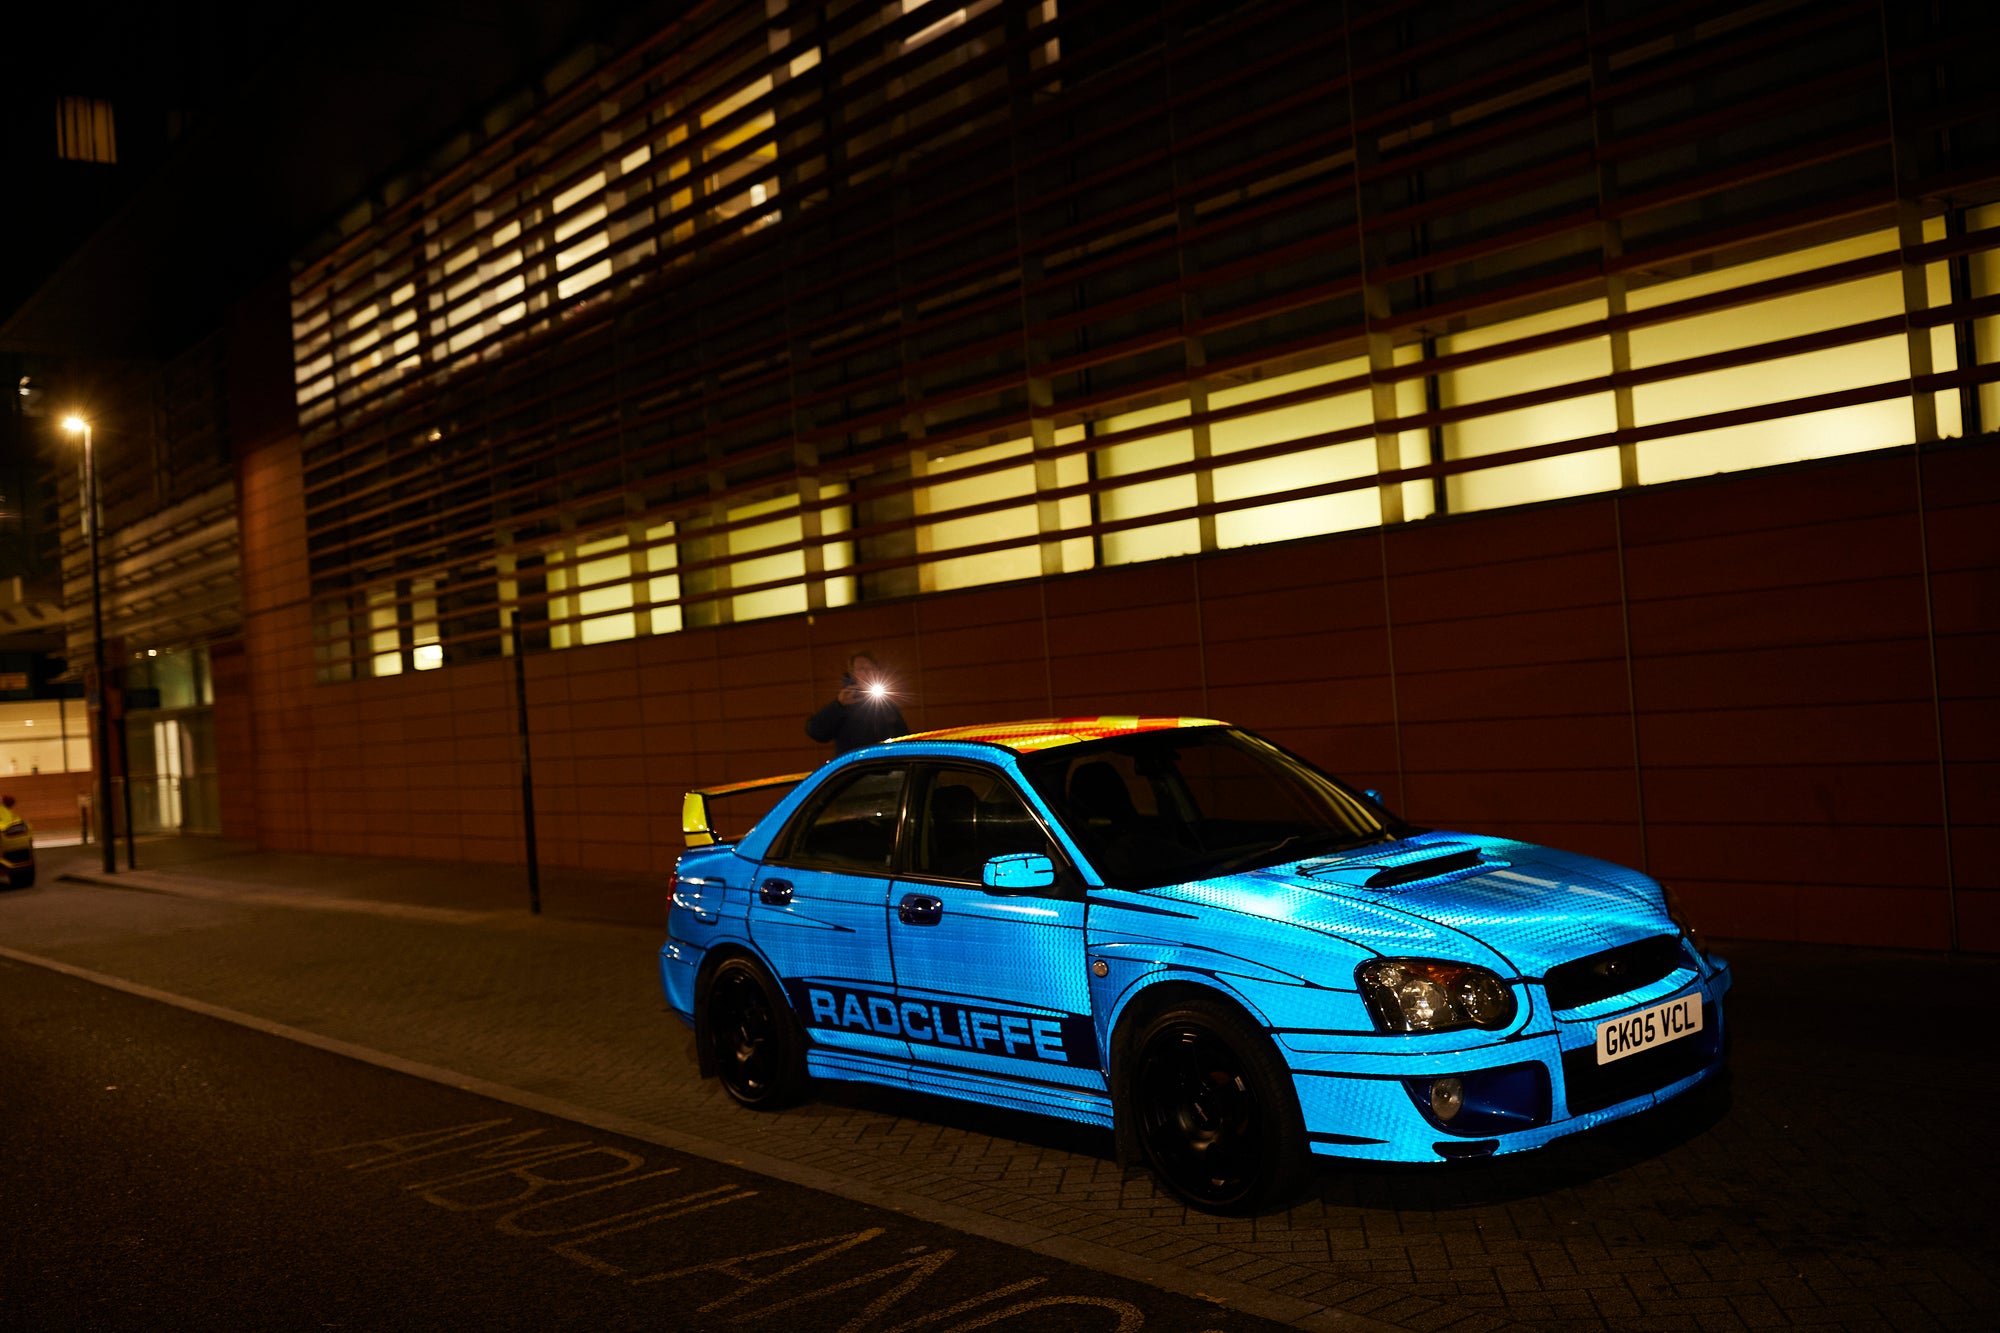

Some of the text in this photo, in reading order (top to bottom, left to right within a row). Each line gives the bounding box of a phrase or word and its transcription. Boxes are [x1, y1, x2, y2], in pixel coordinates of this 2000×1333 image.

[808, 987, 1069, 1062] RADCLIFFE
[1606, 1001, 1695, 1056] GK05 VCL
